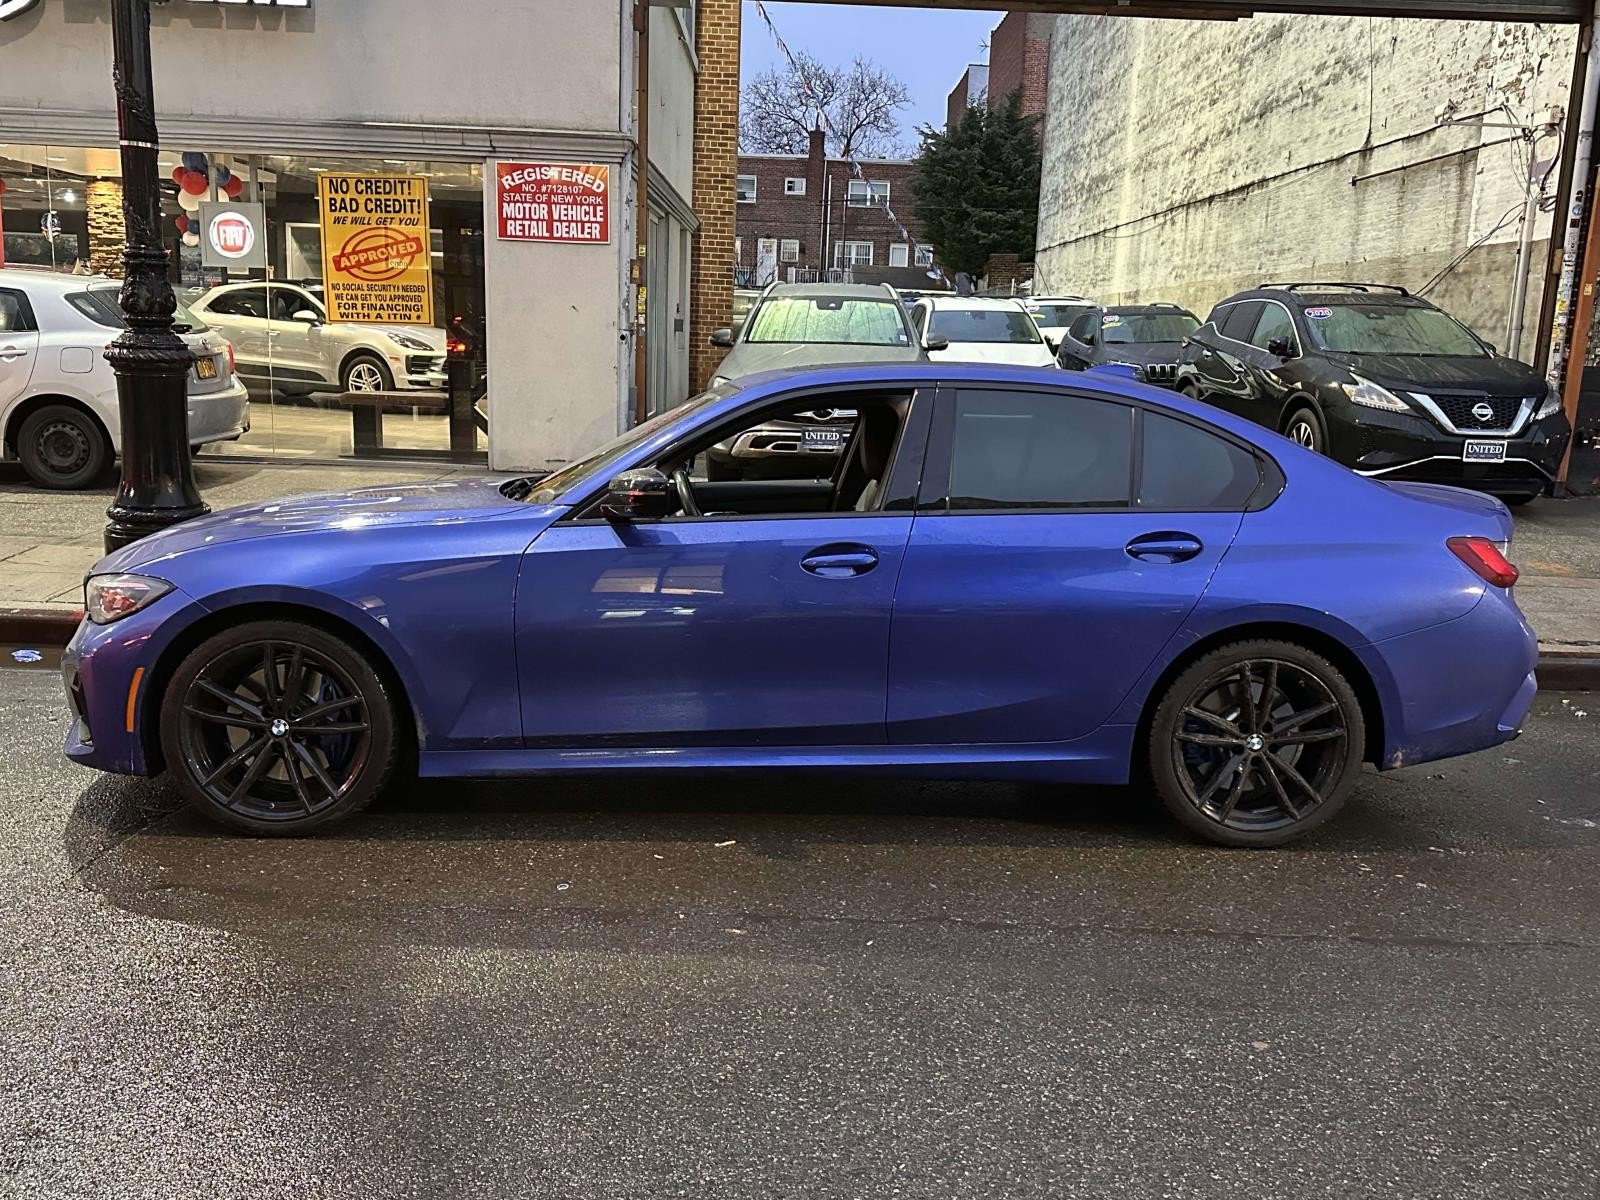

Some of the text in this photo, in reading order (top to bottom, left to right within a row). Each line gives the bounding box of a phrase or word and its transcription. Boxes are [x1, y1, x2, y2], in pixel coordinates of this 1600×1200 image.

[501, 166, 605, 192] REGISTERED
[329, 179, 411, 196] NO CREDIT!
[522, 183, 583, 193] NO. #7128107
[503, 193, 603, 204] STATE OF NEW YORK
[329, 198, 421, 214] BAD CREDIT!
[502, 202, 604, 222] MOTOR VEHICLE
[333, 216, 420, 226] WE WILL GET YOU
[507, 220, 600, 239] RETAIL DEALER
[219, 225, 246, 247] FIAT
[340, 242, 417, 268] APPROVED
[331, 283, 340, 291] NO
[342, 283, 364, 291] SOCIAL
[401, 284, 425, 293] NEEDED
[335, 293, 422, 302] WE CAN GET YOU APPROVED
[337, 302, 423, 312] FOR FINANCING!
[805, 431, 840, 440] UNITED
[1468, 445, 1502, 454] UNITED
